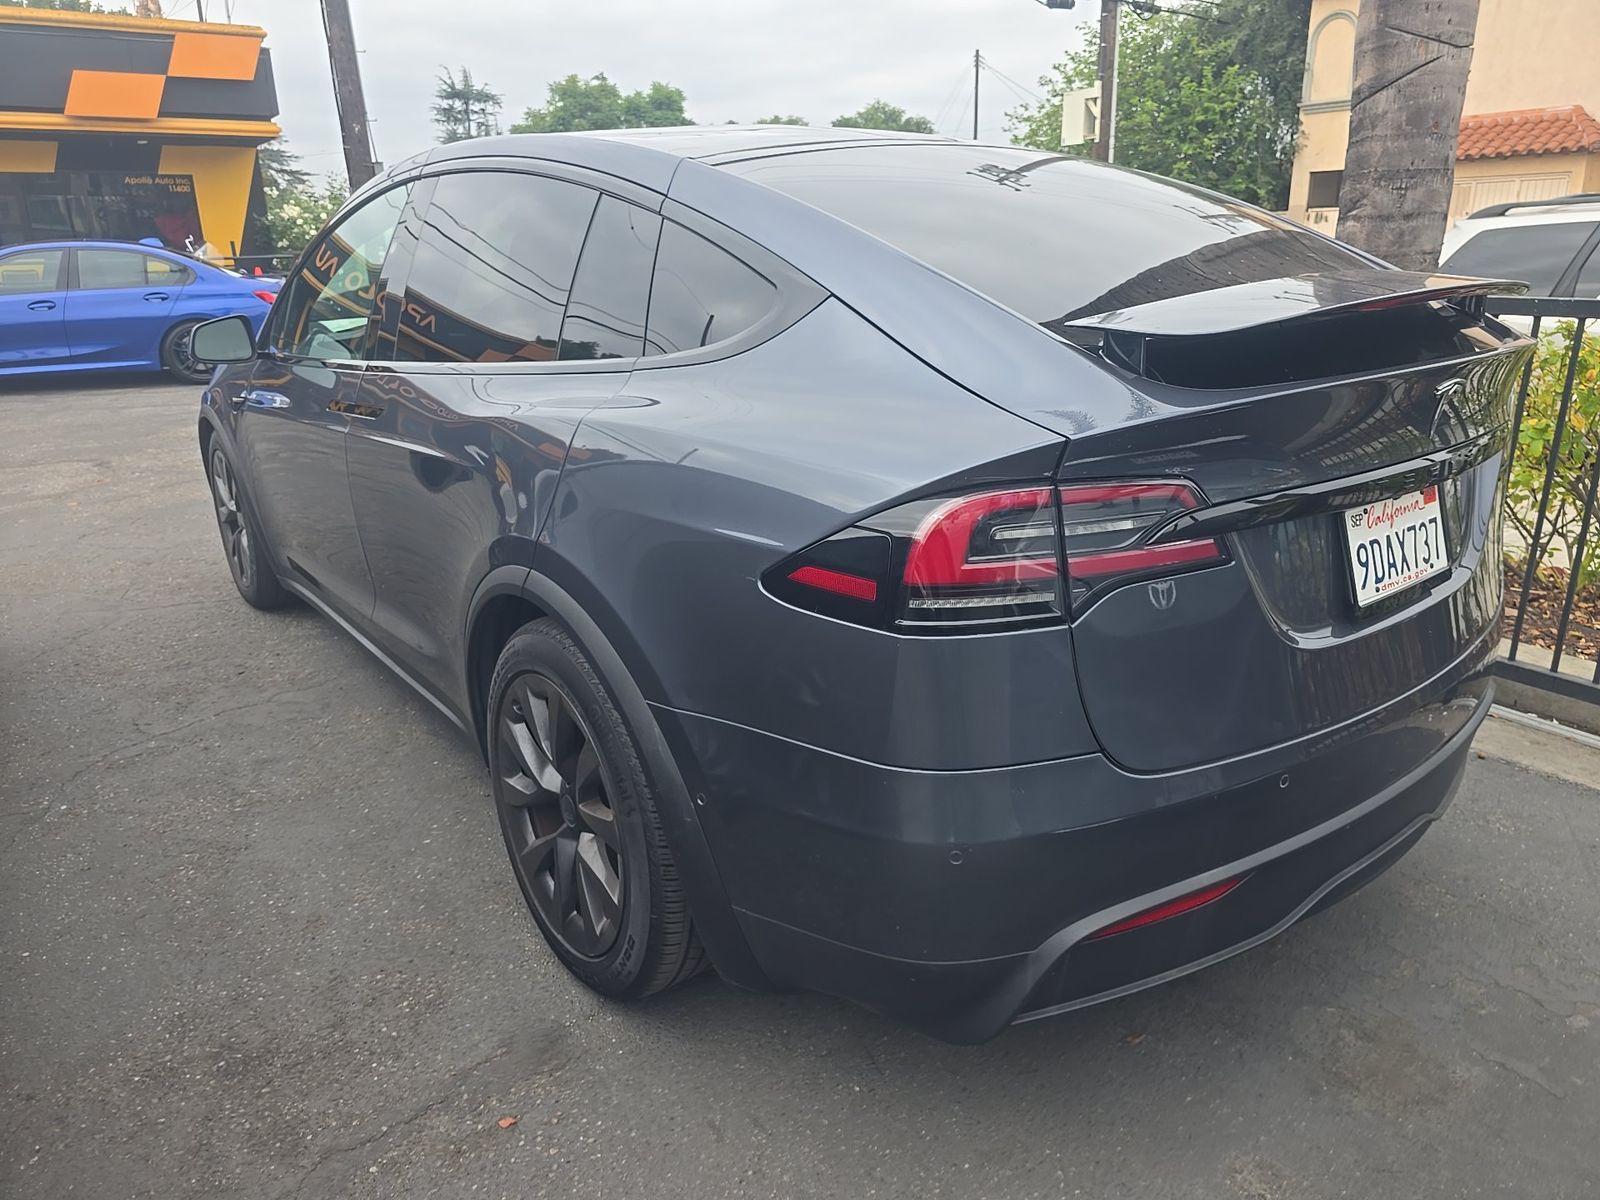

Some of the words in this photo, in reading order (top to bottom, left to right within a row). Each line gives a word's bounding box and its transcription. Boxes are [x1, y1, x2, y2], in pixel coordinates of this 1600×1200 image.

[154, 177, 175, 185] Auto
[1350, 512, 1364, 528] SEP
[1366, 498, 1425, 529] California
[1356, 516, 1440, 591] 9DAX737
[1381, 566, 1428, 592] dmv.ca.gov
